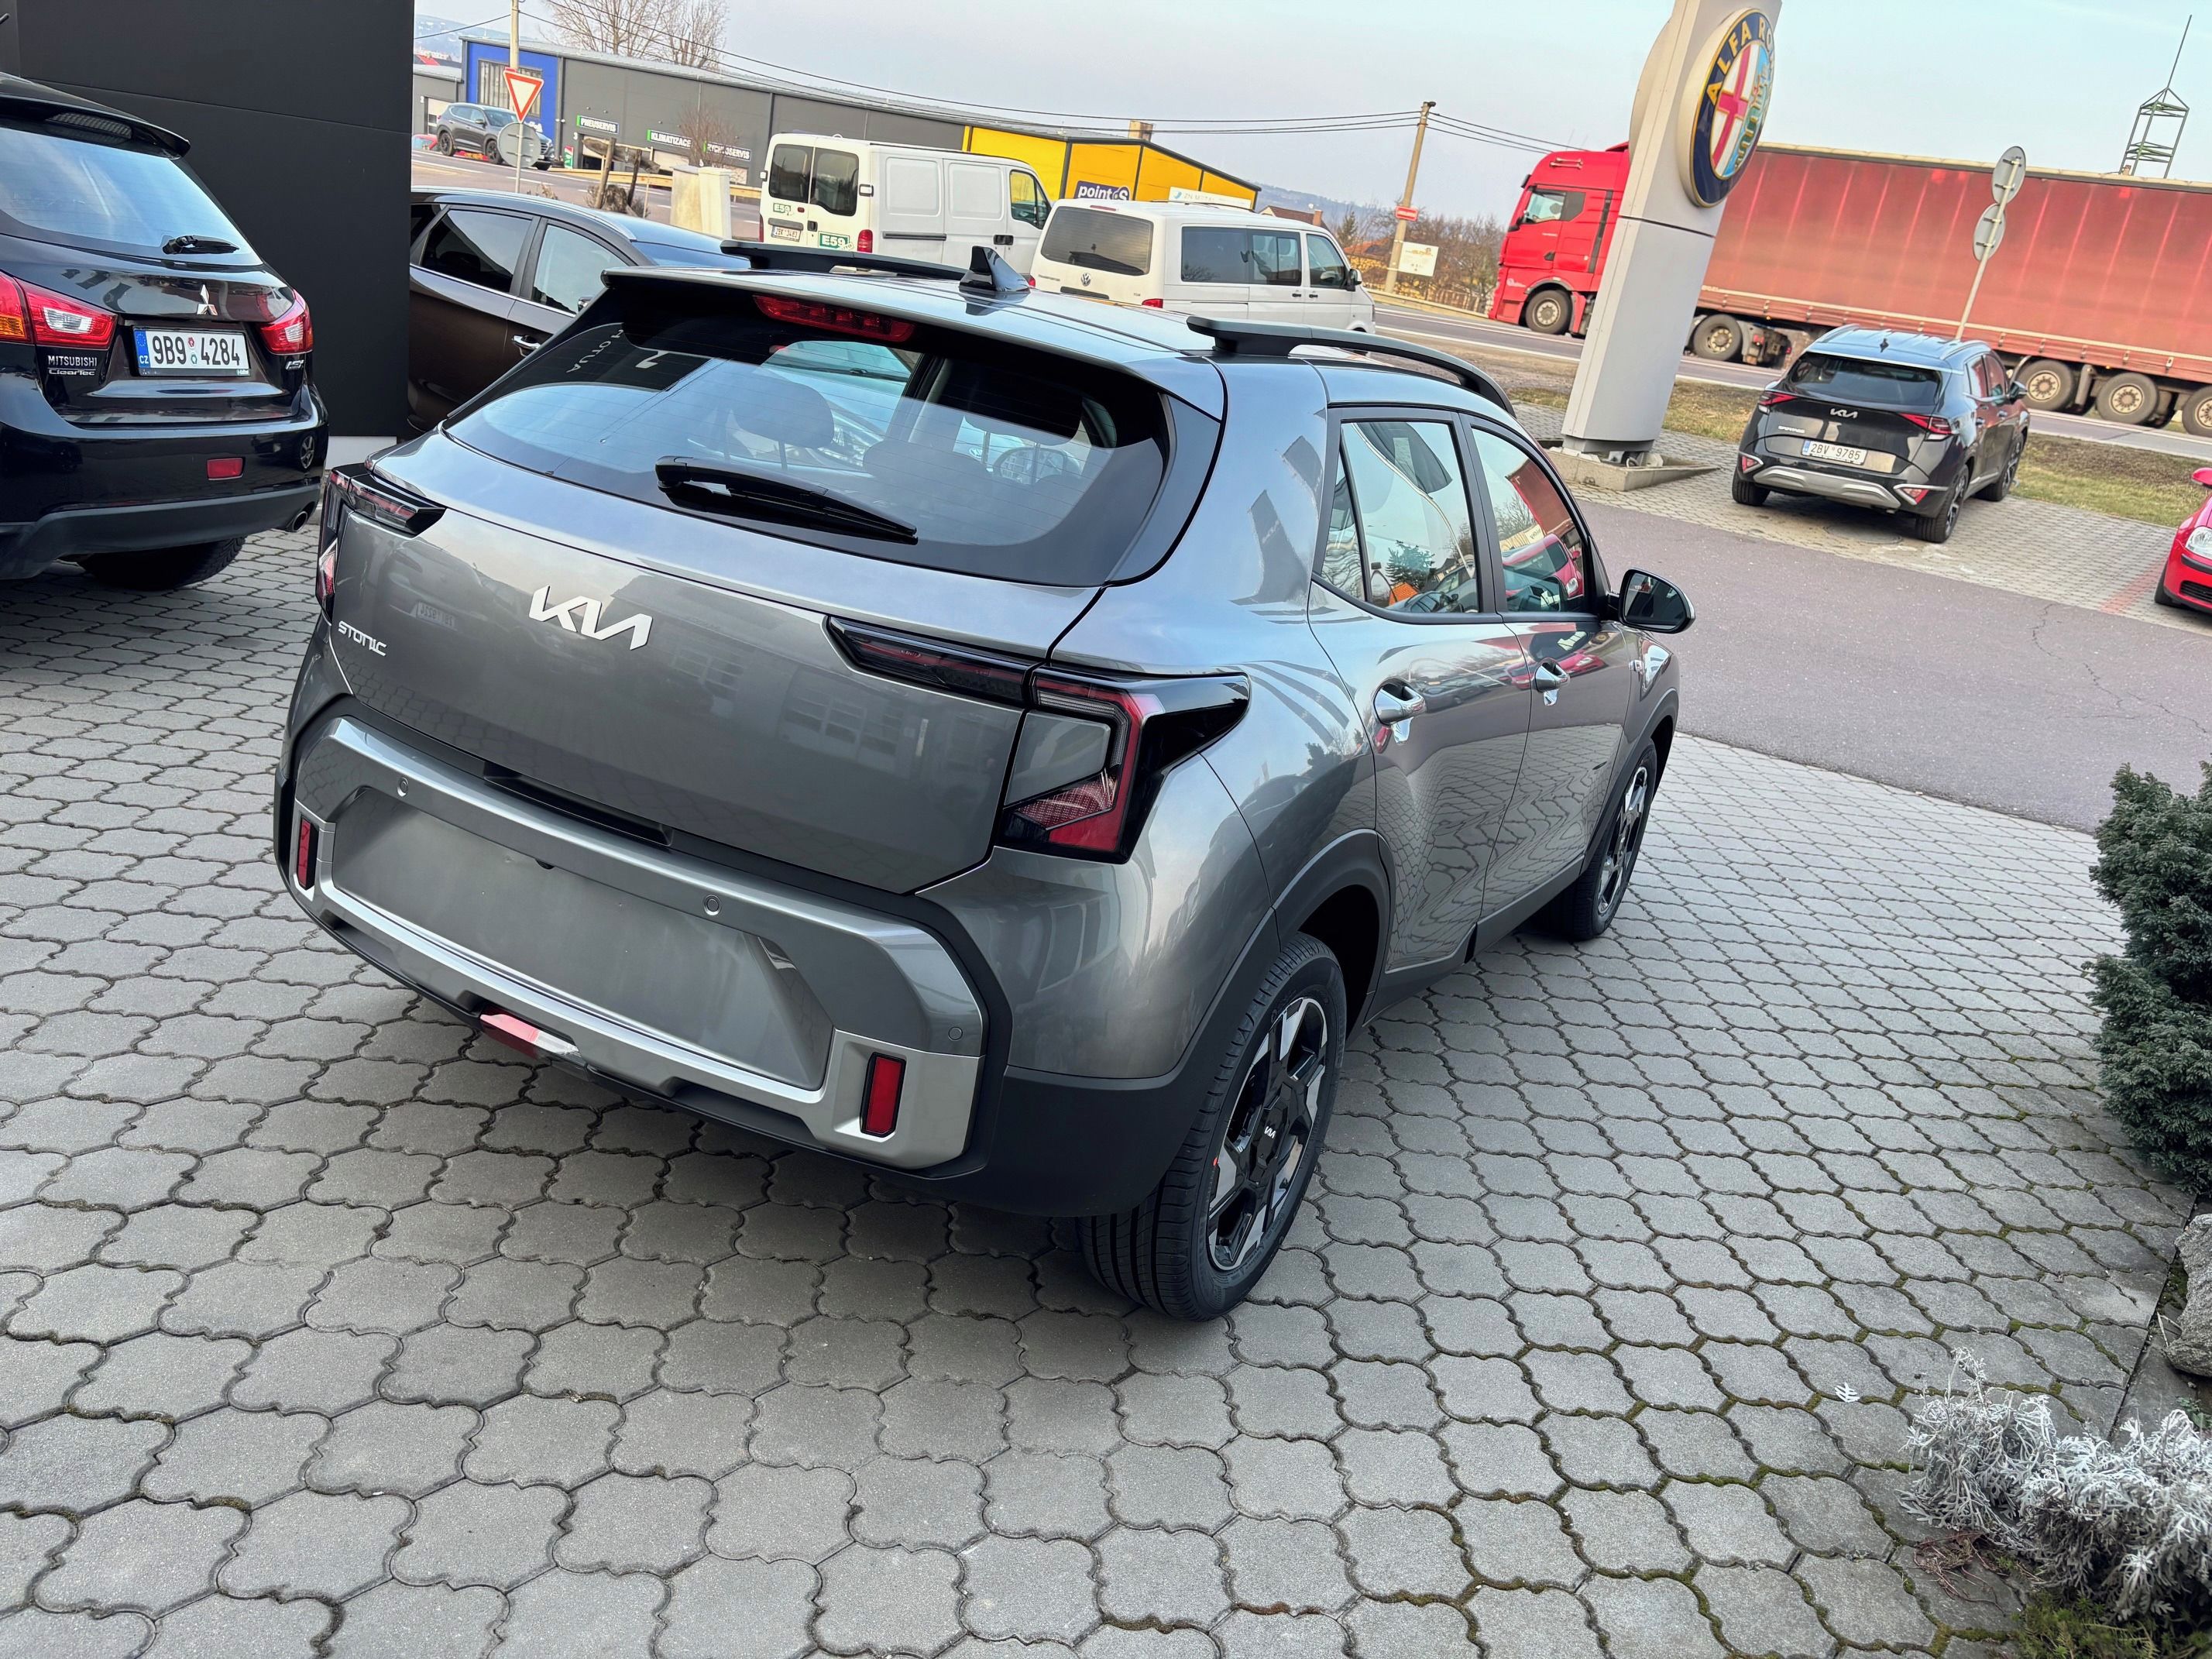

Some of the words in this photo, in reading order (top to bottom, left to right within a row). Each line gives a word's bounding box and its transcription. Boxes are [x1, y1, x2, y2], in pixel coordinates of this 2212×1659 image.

[1707, 21, 1752, 105] ALFA
[580, 118, 617, 132] PNEUSERVIS
[651, 132, 692, 148] KLIMATIZACE
[822, 235, 847, 248] E59
[153, 335, 187, 365] 9B9
[201, 337, 240, 366] 4284
[47, 355, 98, 366] MITSUBISHI
[1830, 408, 1858, 418] KIA
[1811, 443, 1830, 455] 2BV
[1836, 448, 1861, 460] 9785
[528, 585, 653, 651] KIA
[338, 620, 387, 657] STONIC
